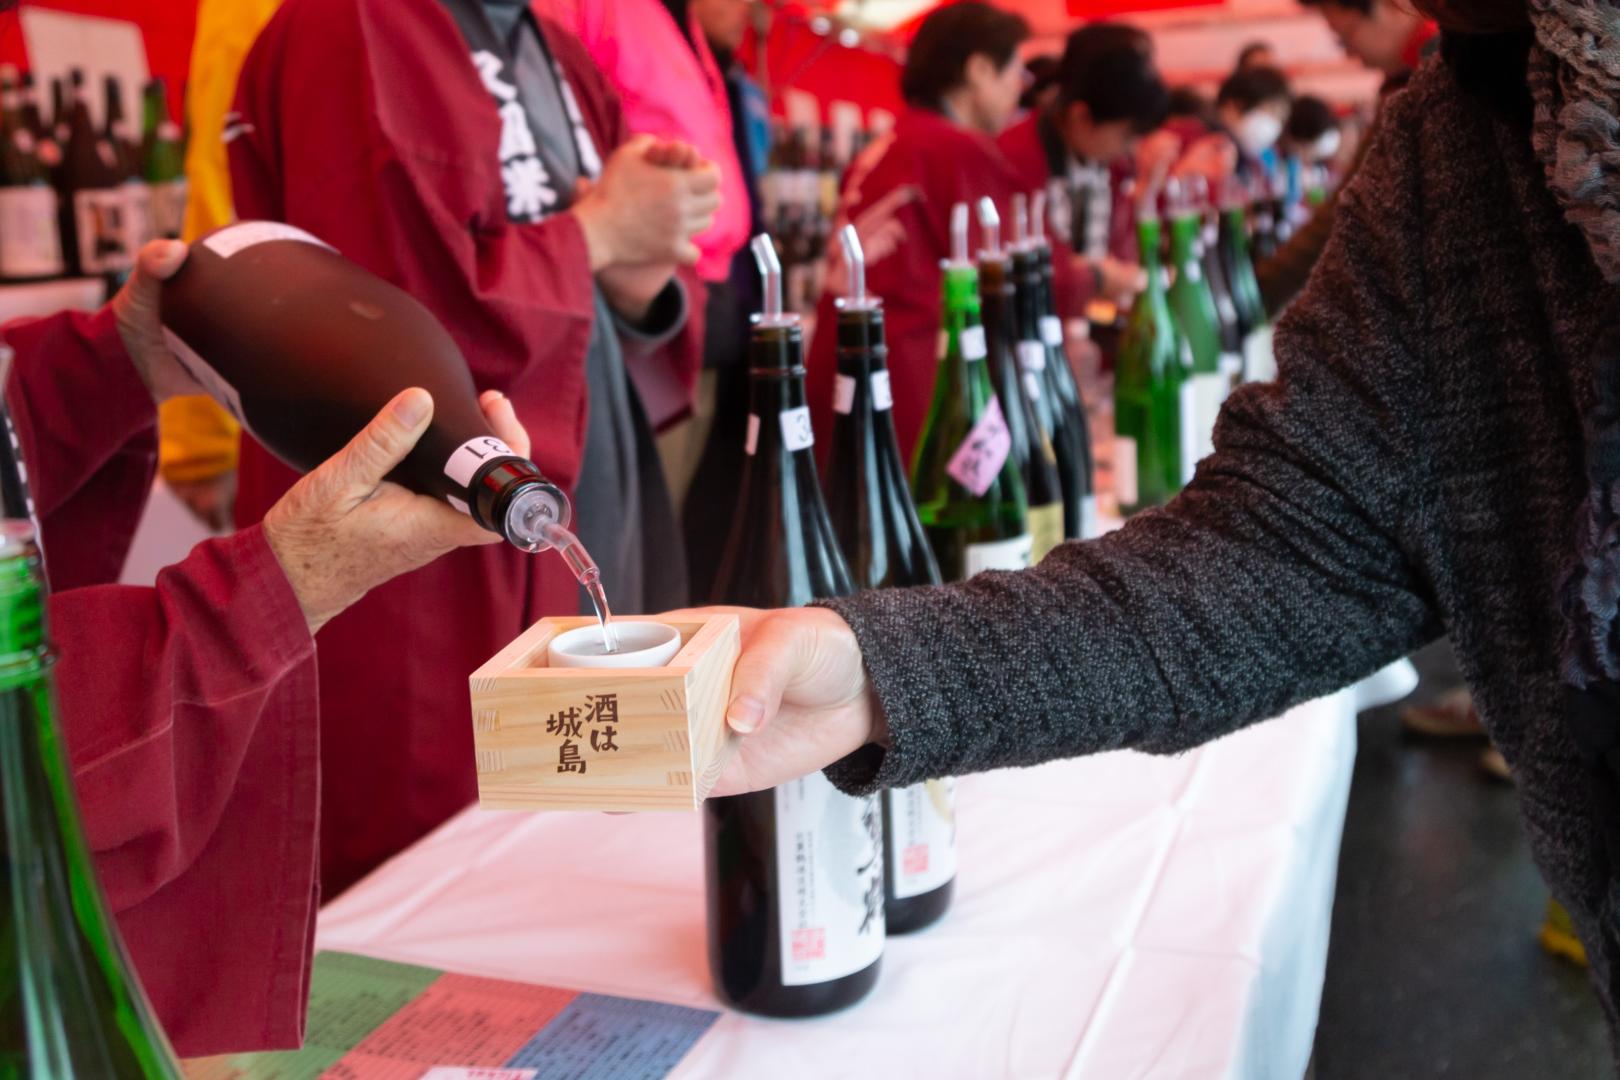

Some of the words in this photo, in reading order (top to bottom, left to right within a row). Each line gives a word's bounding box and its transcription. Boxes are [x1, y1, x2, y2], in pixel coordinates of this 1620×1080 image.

[464, 439, 510, 459] 31
[546, 706, 587, 774] 城島
[584, 693, 619, 752] 酒は
